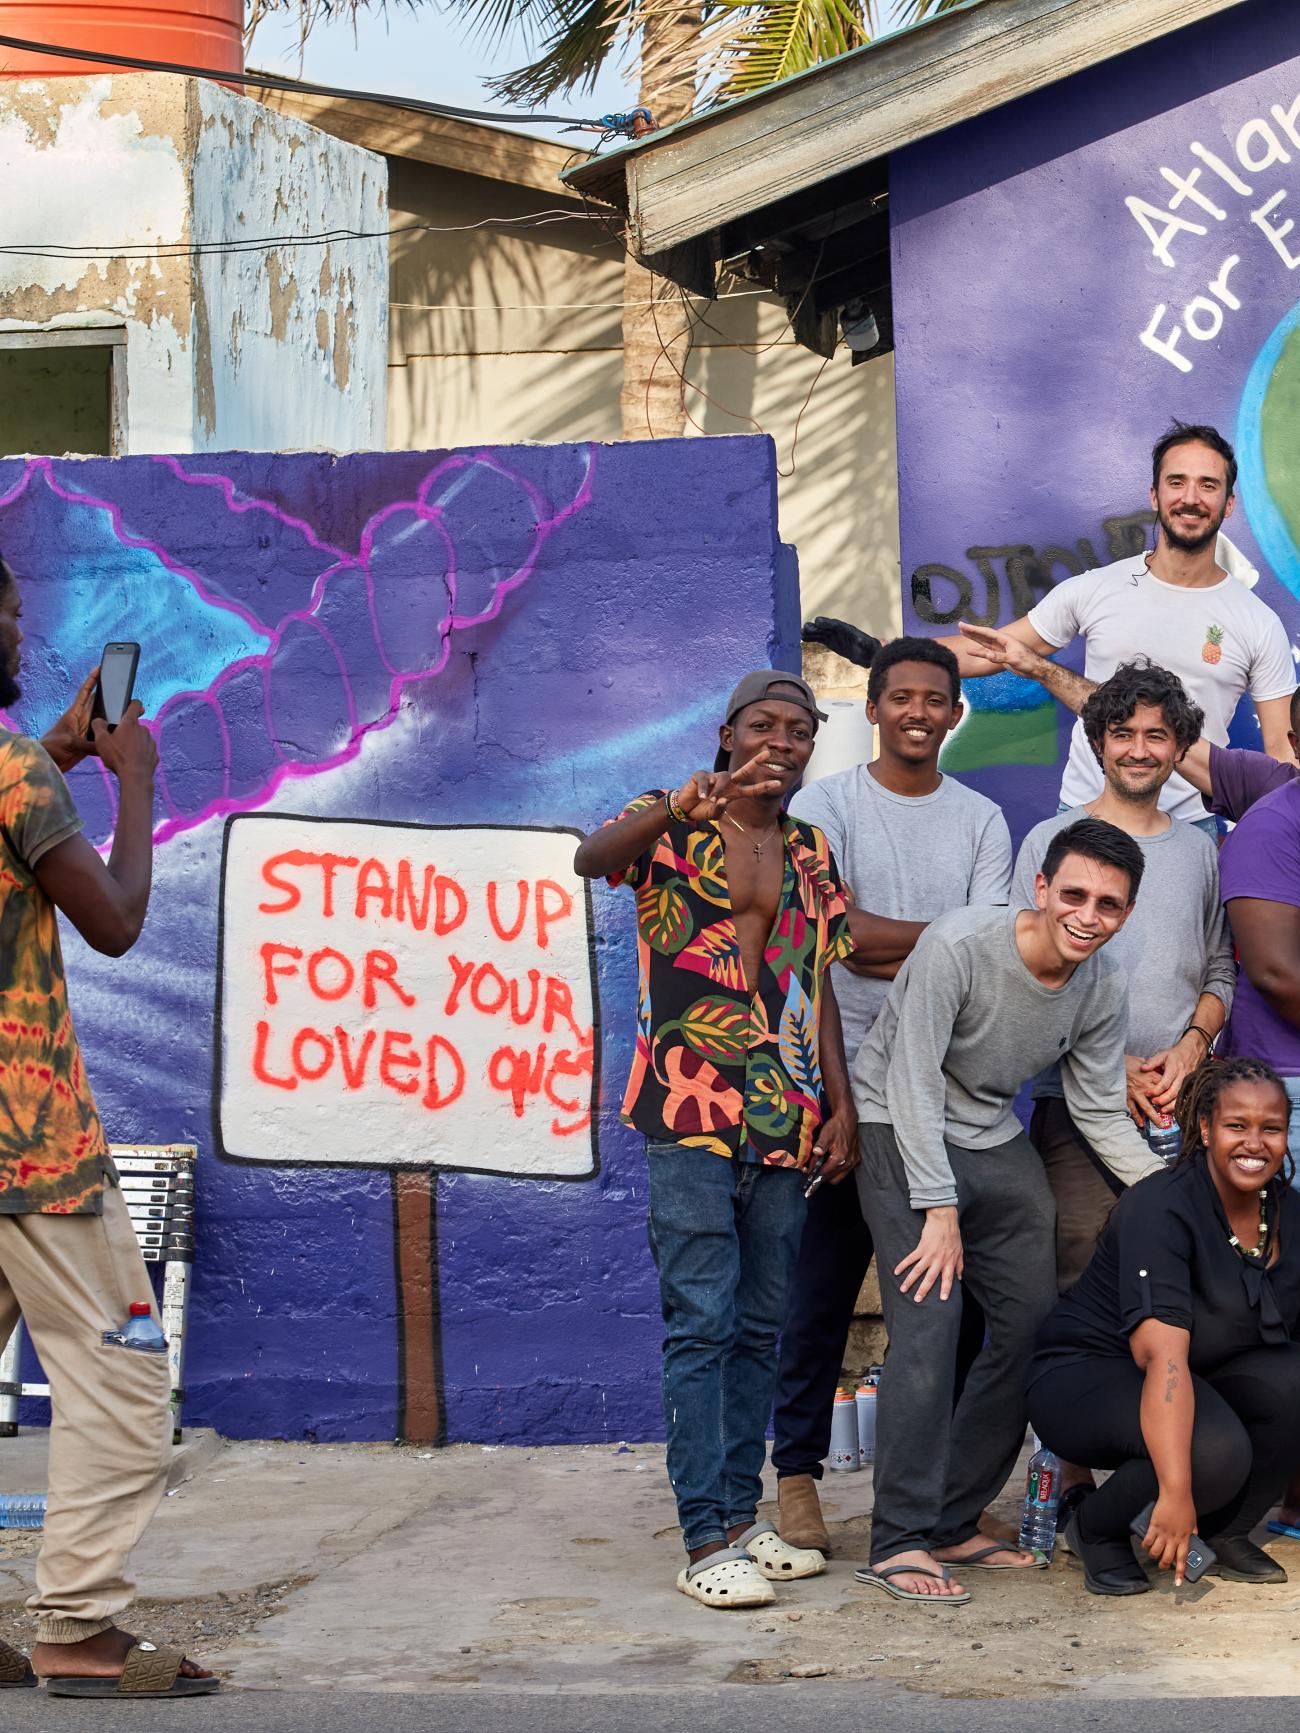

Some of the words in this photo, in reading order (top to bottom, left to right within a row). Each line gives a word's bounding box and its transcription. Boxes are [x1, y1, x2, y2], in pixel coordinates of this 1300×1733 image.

[1140, 254, 1239, 373] For
[259, 848, 468, 936] STAND
[487, 878, 573, 949] UP
[260, 942, 417, 1008] FOR
[444, 953, 594, 1047] YOUR
[252, 1021, 466, 1110] LOVED
